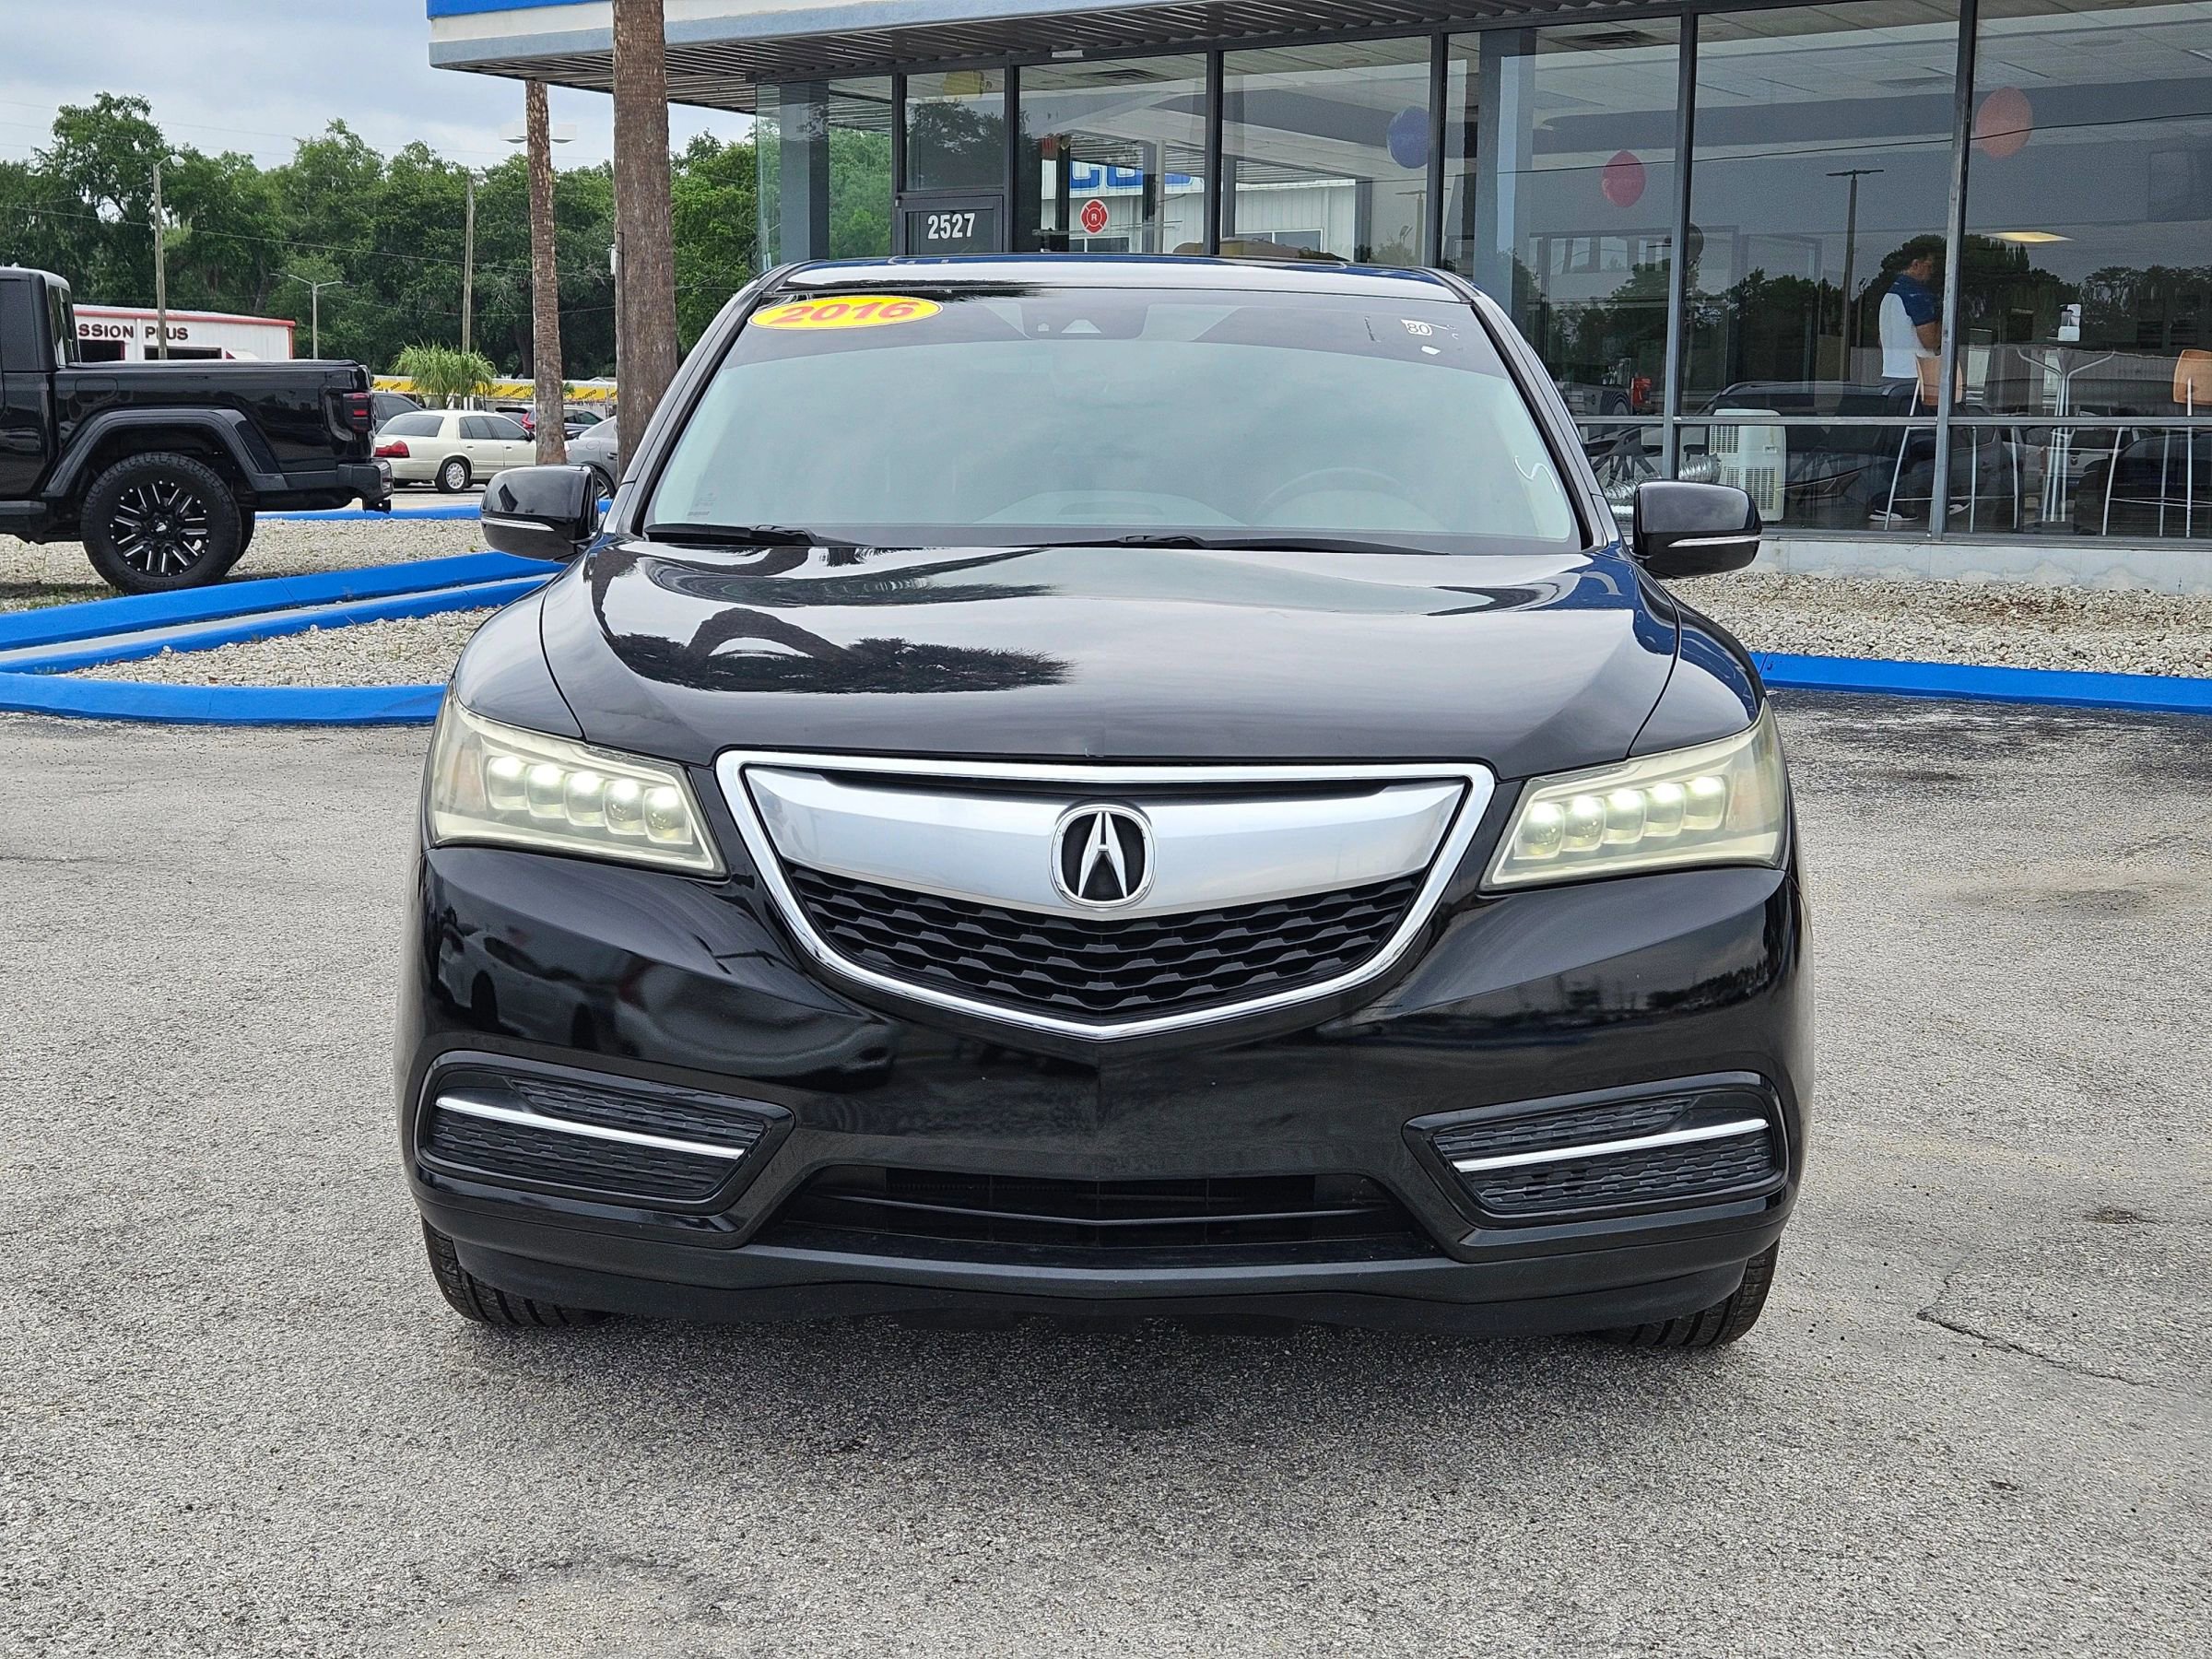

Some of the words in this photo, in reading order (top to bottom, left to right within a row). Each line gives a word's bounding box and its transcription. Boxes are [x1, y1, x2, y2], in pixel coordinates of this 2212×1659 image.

[927, 213, 975, 240] 2527
[1090, 213, 1098, 221] R
[769, 301, 920, 324] 2016
